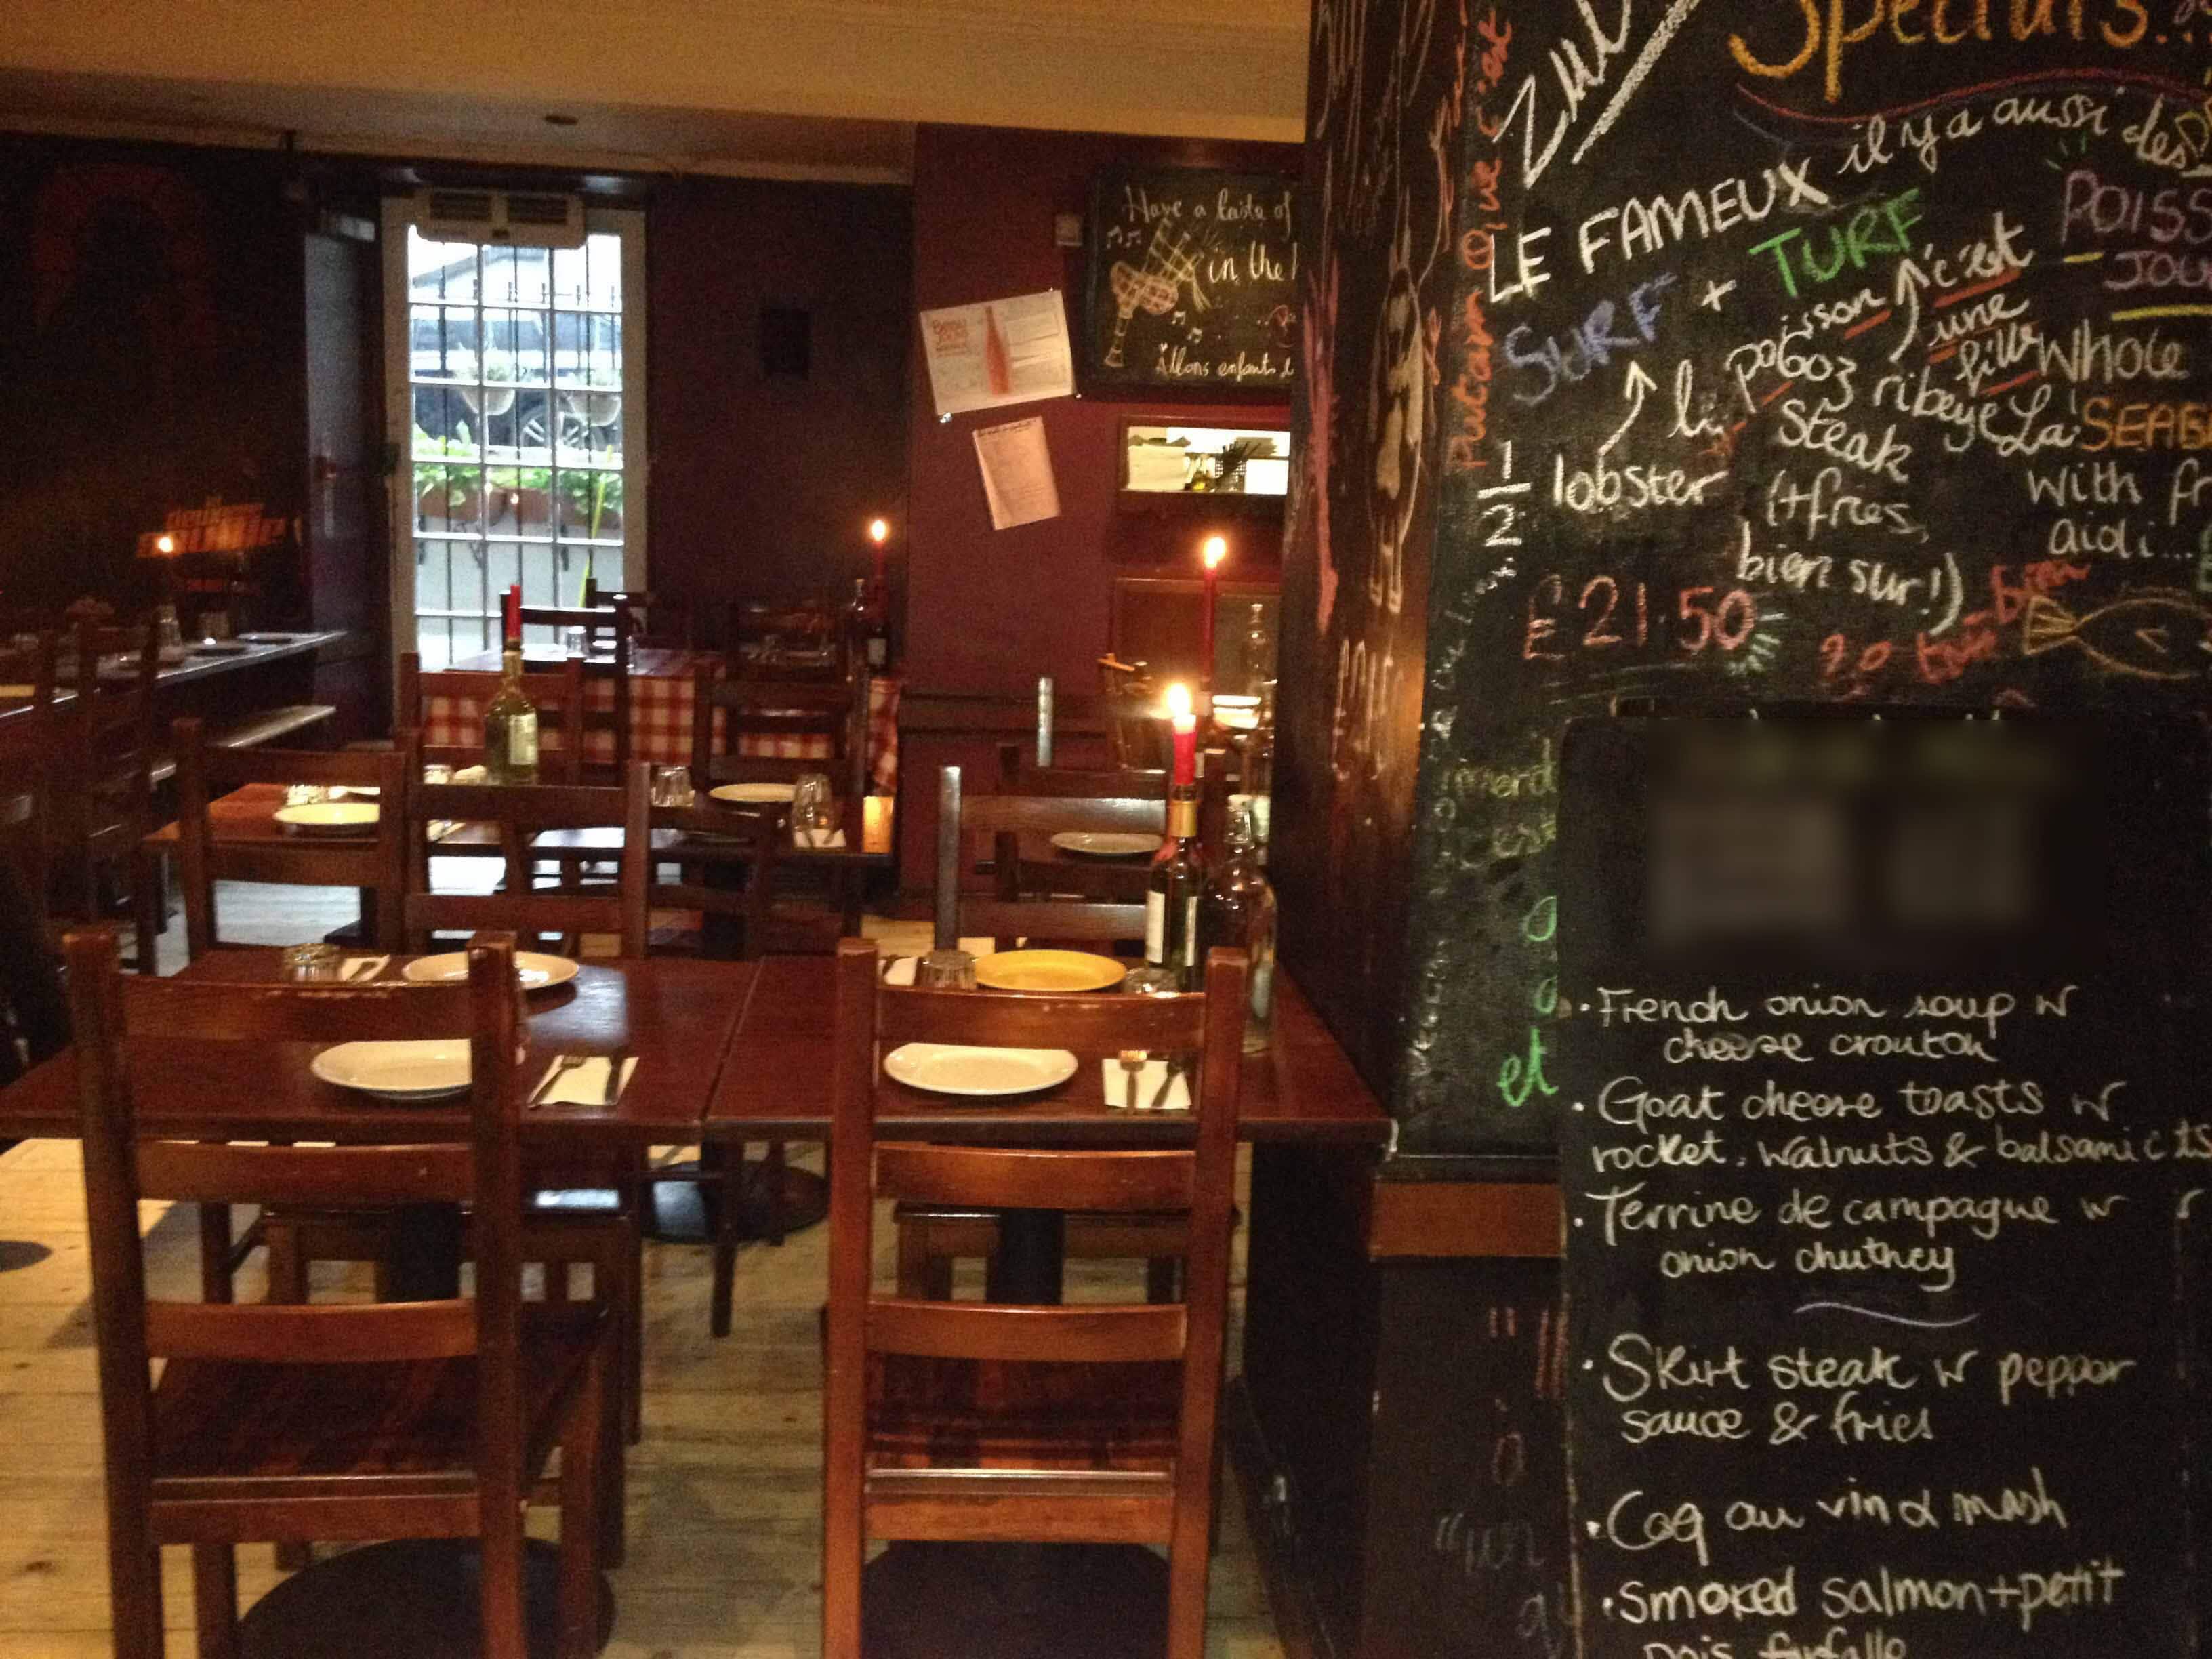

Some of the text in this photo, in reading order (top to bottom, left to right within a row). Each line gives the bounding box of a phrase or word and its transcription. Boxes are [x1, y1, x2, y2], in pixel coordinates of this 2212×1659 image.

[1994, 86, 2109, 135] aussi
[1490, 157, 1830, 303] LE FAMEUX
[1748, 188, 1923, 298] TURF
[1210, 245, 1237, 283] in
[1551, 453, 1730, 512] lobster
[1596, 985, 1750, 1027] French
[1766, 983, 1887, 1018] onion
[1903, 992, 2017, 1040] soup
[1830, 1029, 1999, 1063] crouton
[1598, 1075, 1726, 1134] Goat
[1897, 1078, 2045, 1120] toasts
[1586, 1182, 1763, 1247] Terrine
[1778, 1187, 1832, 1229] de
[1843, 1195, 2059, 1242] campagne
[1660, 1236, 1957, 1293] onion chutney
[1767, 1346, 1919, 1391] steak
[1725, 1500, 1806, 1530] au
[1816, 1476, 1891, 1526] vin
